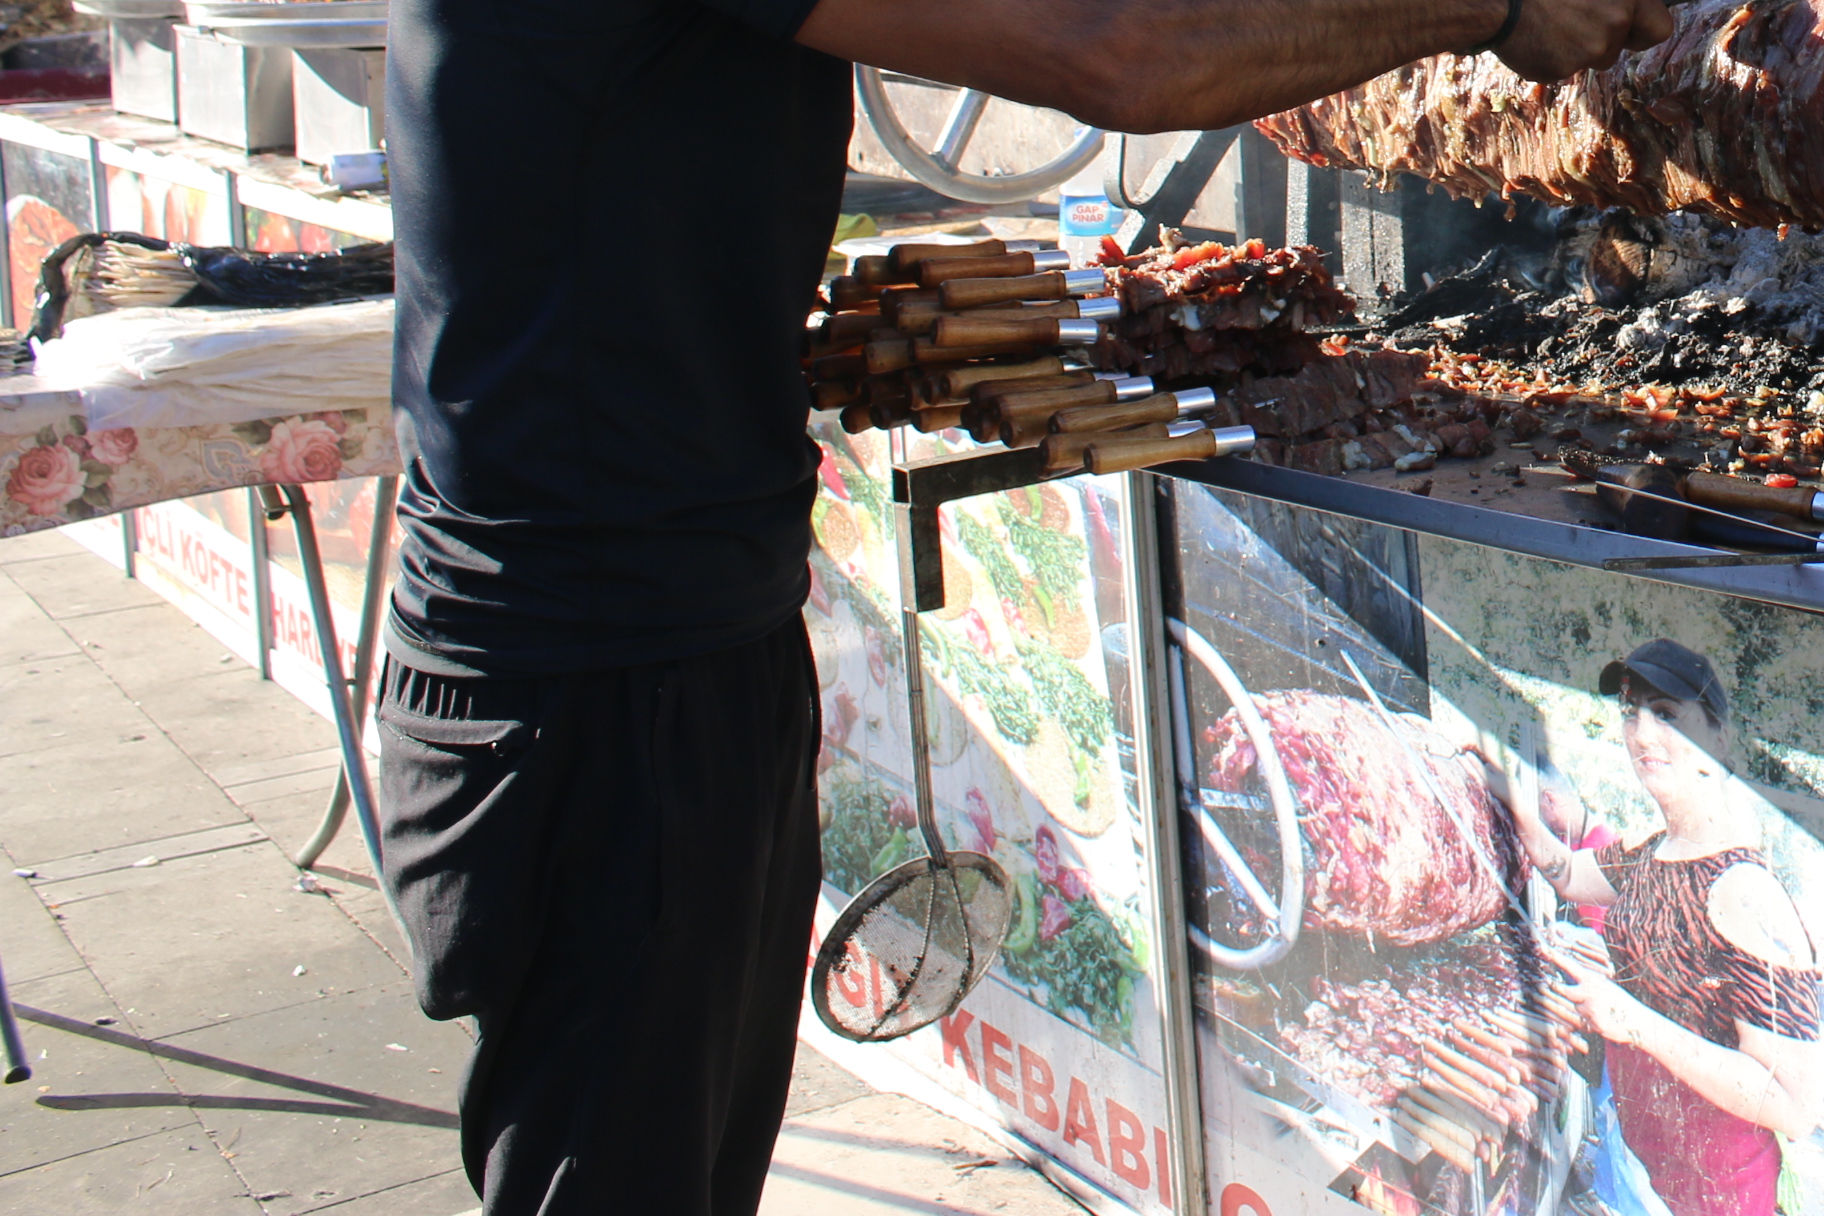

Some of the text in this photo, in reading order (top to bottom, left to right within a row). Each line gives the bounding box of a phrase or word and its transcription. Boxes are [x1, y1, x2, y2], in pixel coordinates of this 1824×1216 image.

[1072, 213, 1104, 222] PINAR
[1076, 205, 1099, 214] GAP
[179, 528, 251, 619] KÖFTE
[940, 1007, 1172, 1210] KEBABI
